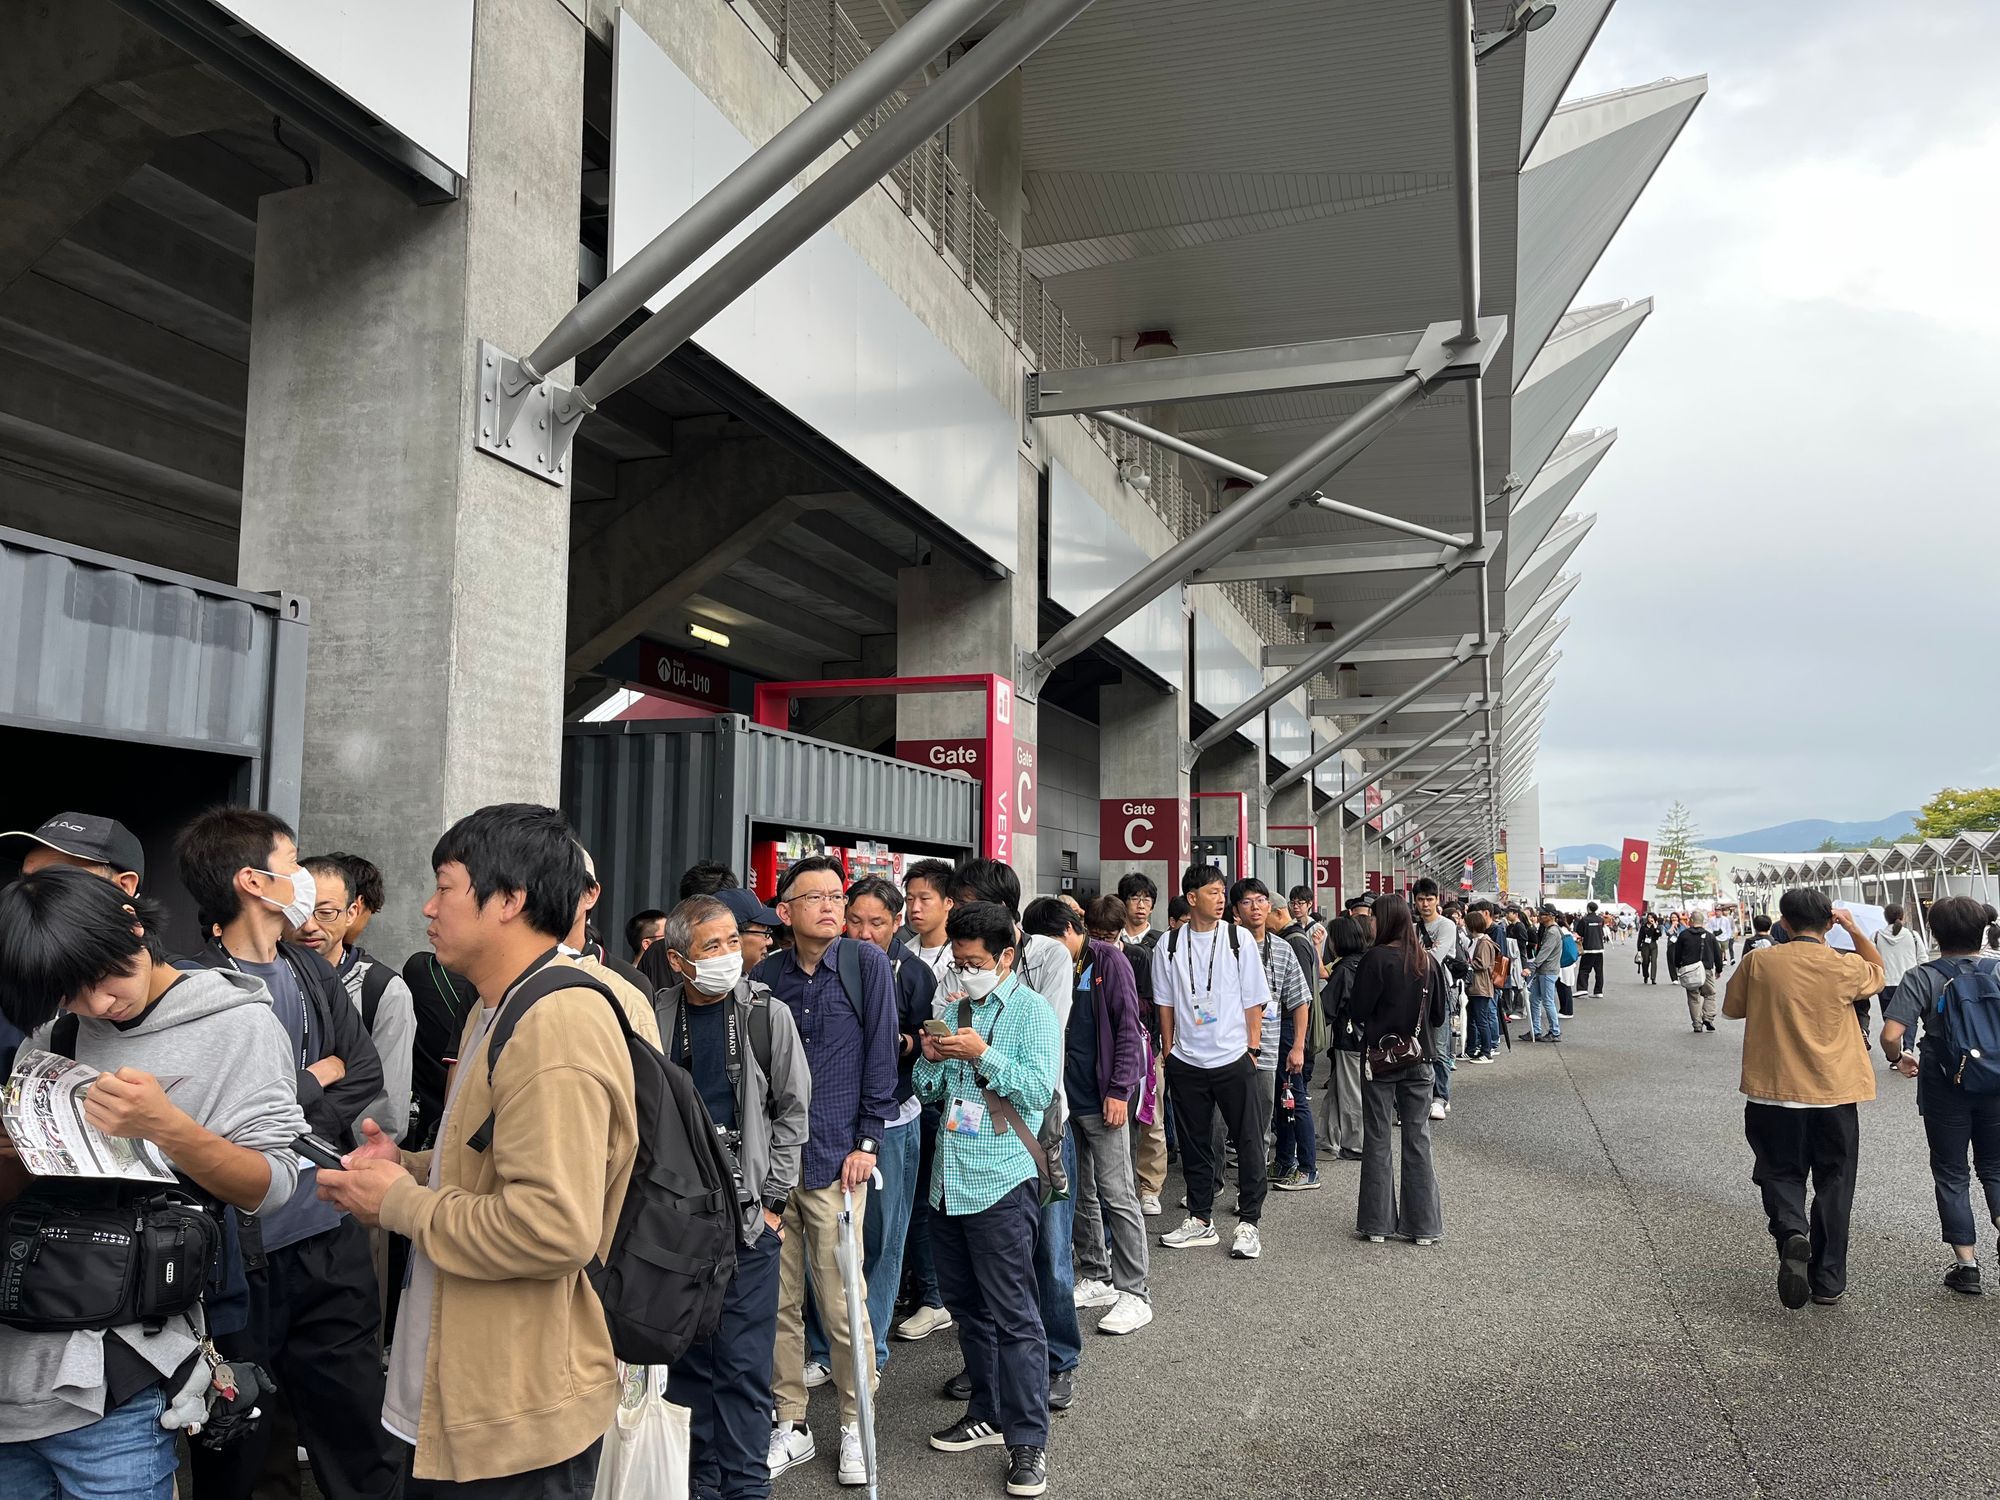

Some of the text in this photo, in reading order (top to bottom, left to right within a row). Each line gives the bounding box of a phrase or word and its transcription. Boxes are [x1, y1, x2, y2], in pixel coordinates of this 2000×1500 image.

[929, 746, 977, 765] Gate
[1016, 746, 1033, 768] Gate
[1017, 771, 1032, 824] C
[1122, 803, 1156, 816] Gate
[997, 791, 1008, 864] VEN
[1124, 818, 1154, 854] C
[1181, 819, 1189, 855] C
[728, 1014, 737, 1056] OLYMPUS
[10, 1264, 24, 1310] VIESEN
